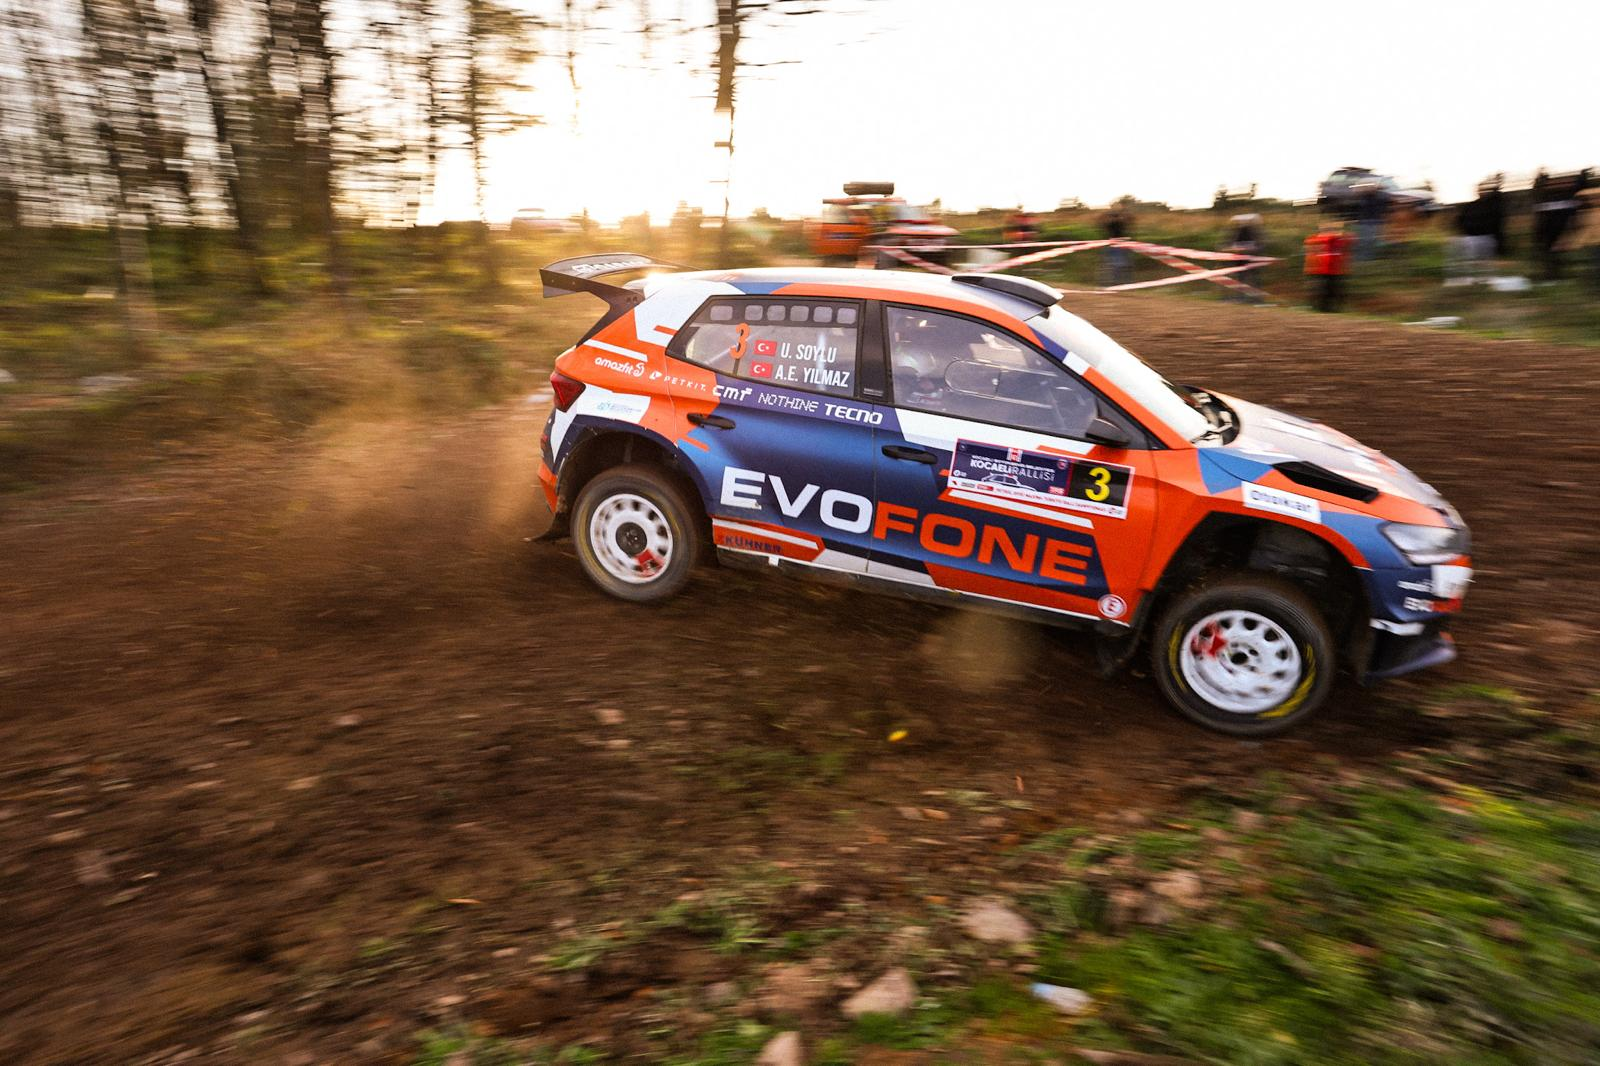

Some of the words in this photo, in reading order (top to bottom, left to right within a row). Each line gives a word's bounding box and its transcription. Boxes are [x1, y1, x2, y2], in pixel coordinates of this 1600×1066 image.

[729, 322, 751, 360] 3
[780, 343, 792, 360] U.
[796, 344, 837, 363] SOYLU
[594, 357, 634, 375] amazfit
[775, 365, 799, 382] A.E.
[803, 367, 851, 388] YILMAZ
[825, 403, 884, 425] TECNO
[1084, 466, 1112, 502] 3
